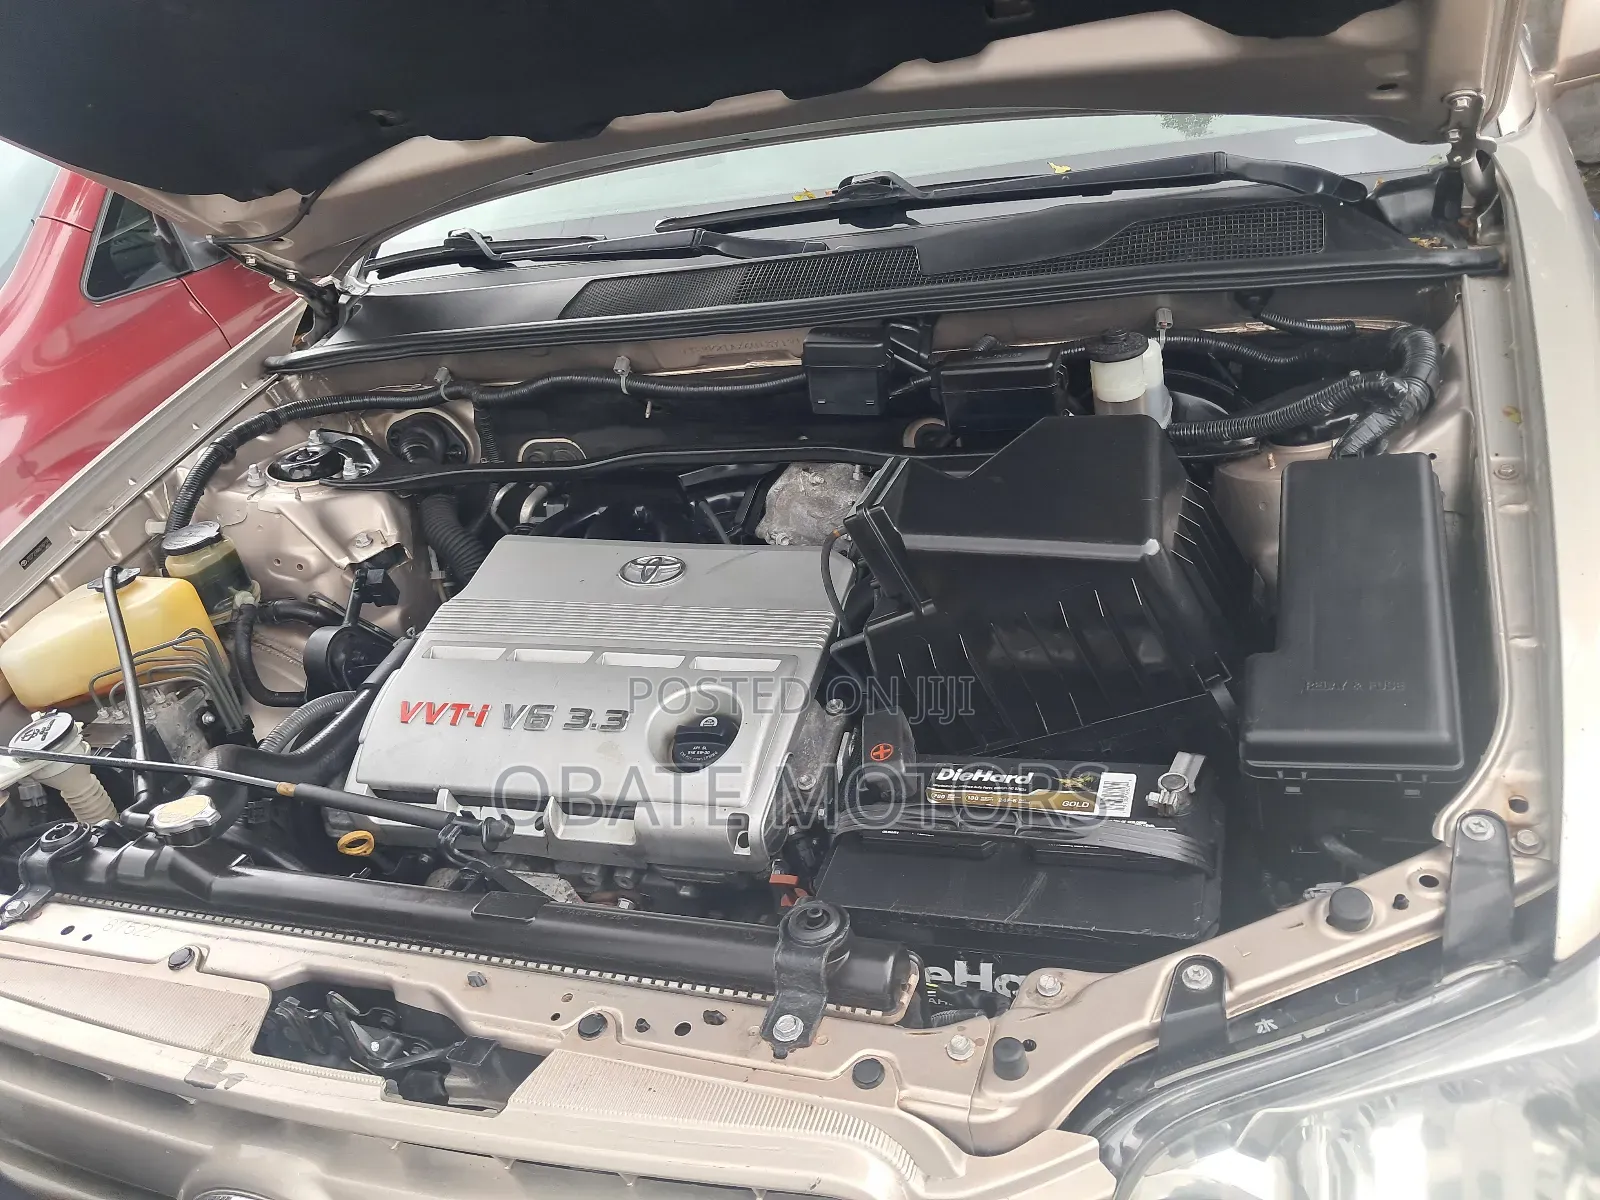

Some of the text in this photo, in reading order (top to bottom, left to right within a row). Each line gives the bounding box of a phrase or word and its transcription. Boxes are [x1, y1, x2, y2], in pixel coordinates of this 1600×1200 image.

[400, 701, 631, 732] VVT-i V6 3.3
[936, 768, 1034, 784] DieHard
[1062, 800, 1090, 809] GOLD
